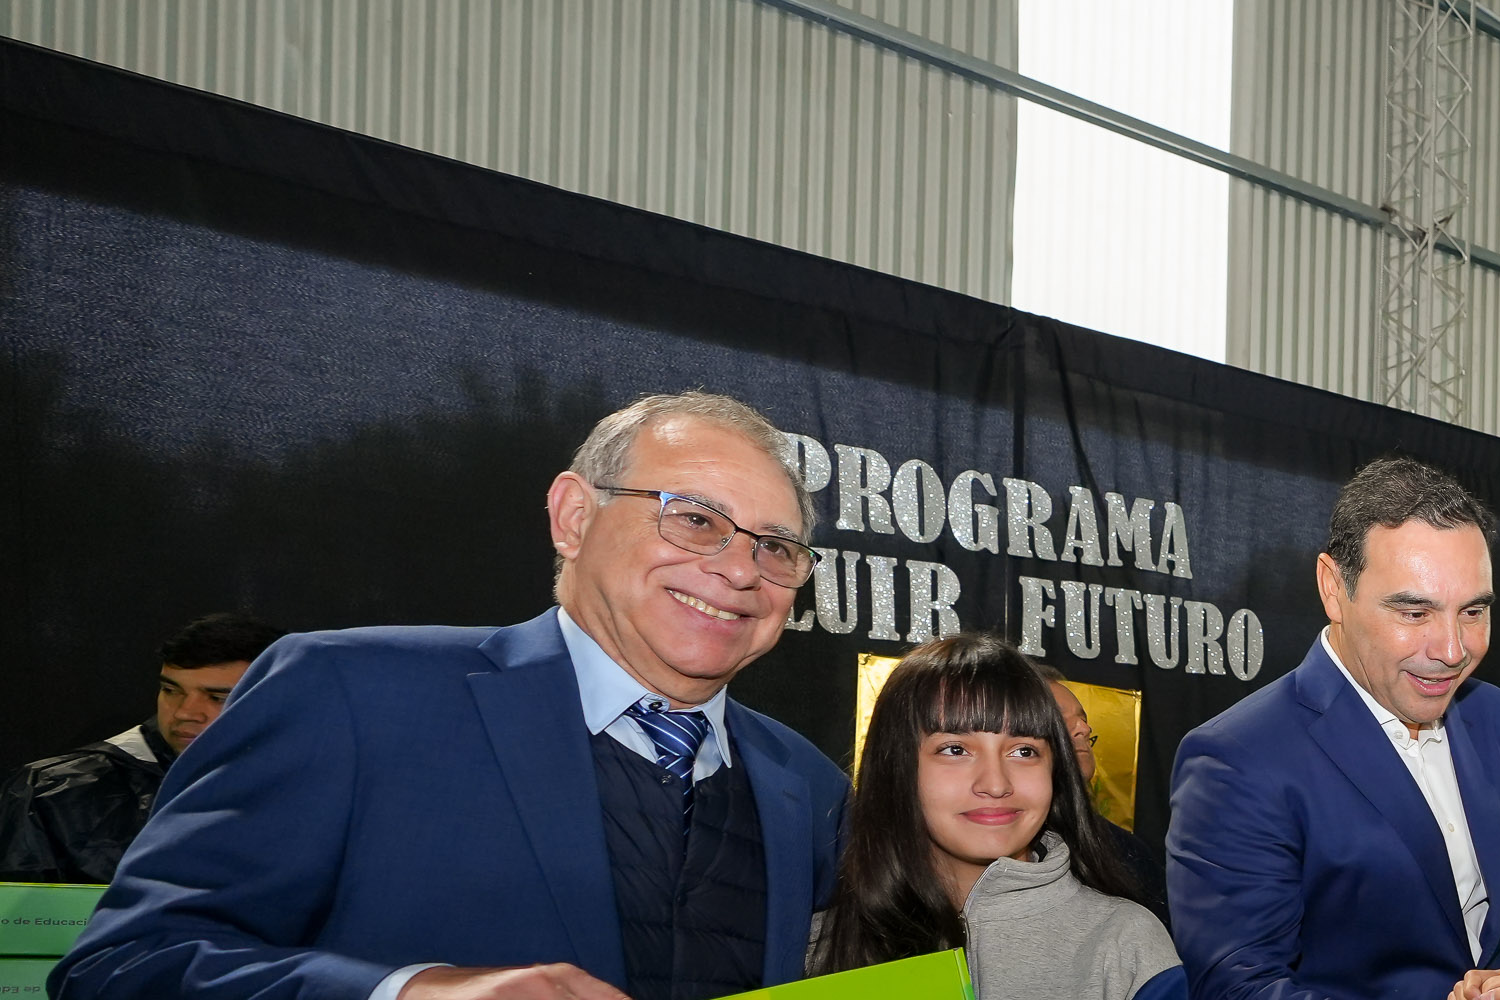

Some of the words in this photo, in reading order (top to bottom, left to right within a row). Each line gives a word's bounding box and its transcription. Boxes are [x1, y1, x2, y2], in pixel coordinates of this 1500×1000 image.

[780, 432, 1193, 579] PROGRAMA
[1018, 576, 1264, 681] FUTURO
[35, 917, 88, 926] Educaci
